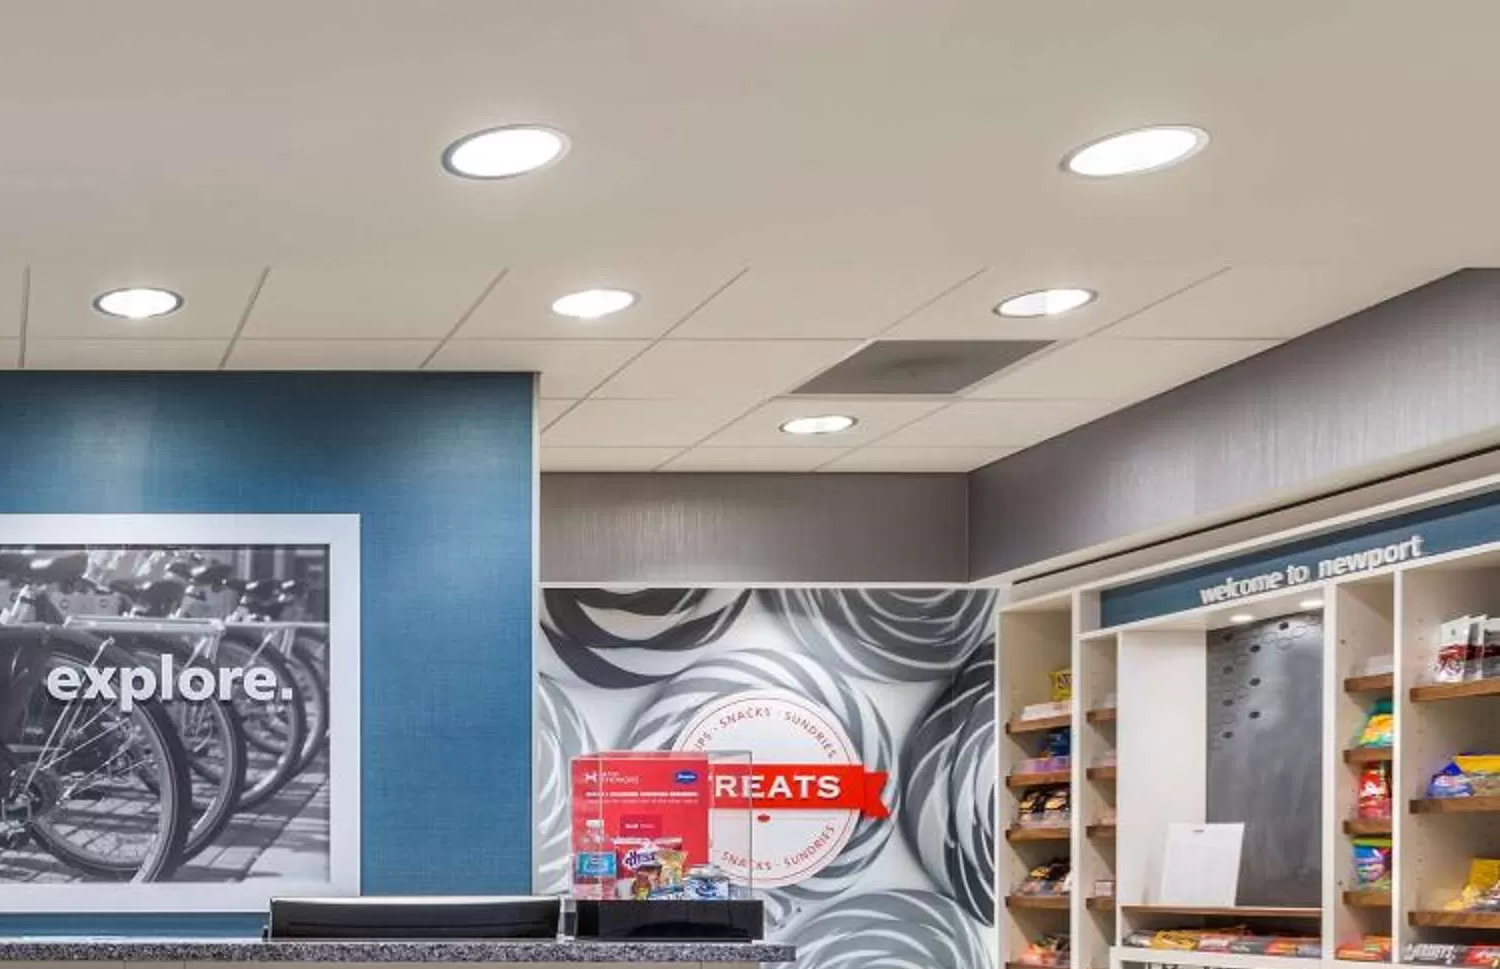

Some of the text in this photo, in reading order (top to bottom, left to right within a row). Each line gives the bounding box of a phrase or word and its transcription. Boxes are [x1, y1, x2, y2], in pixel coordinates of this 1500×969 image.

[1200, 534, 1425, 605] welcome to newport
[47, 653, 294, 712] explore.
[719, 706, 773, 729] SNACKS
[784, 711, 838, 760] SUNDRIES
[708, 774, 842, 800] REATS
[721, 823, 837, 872] SNACKS SUNDRIES
